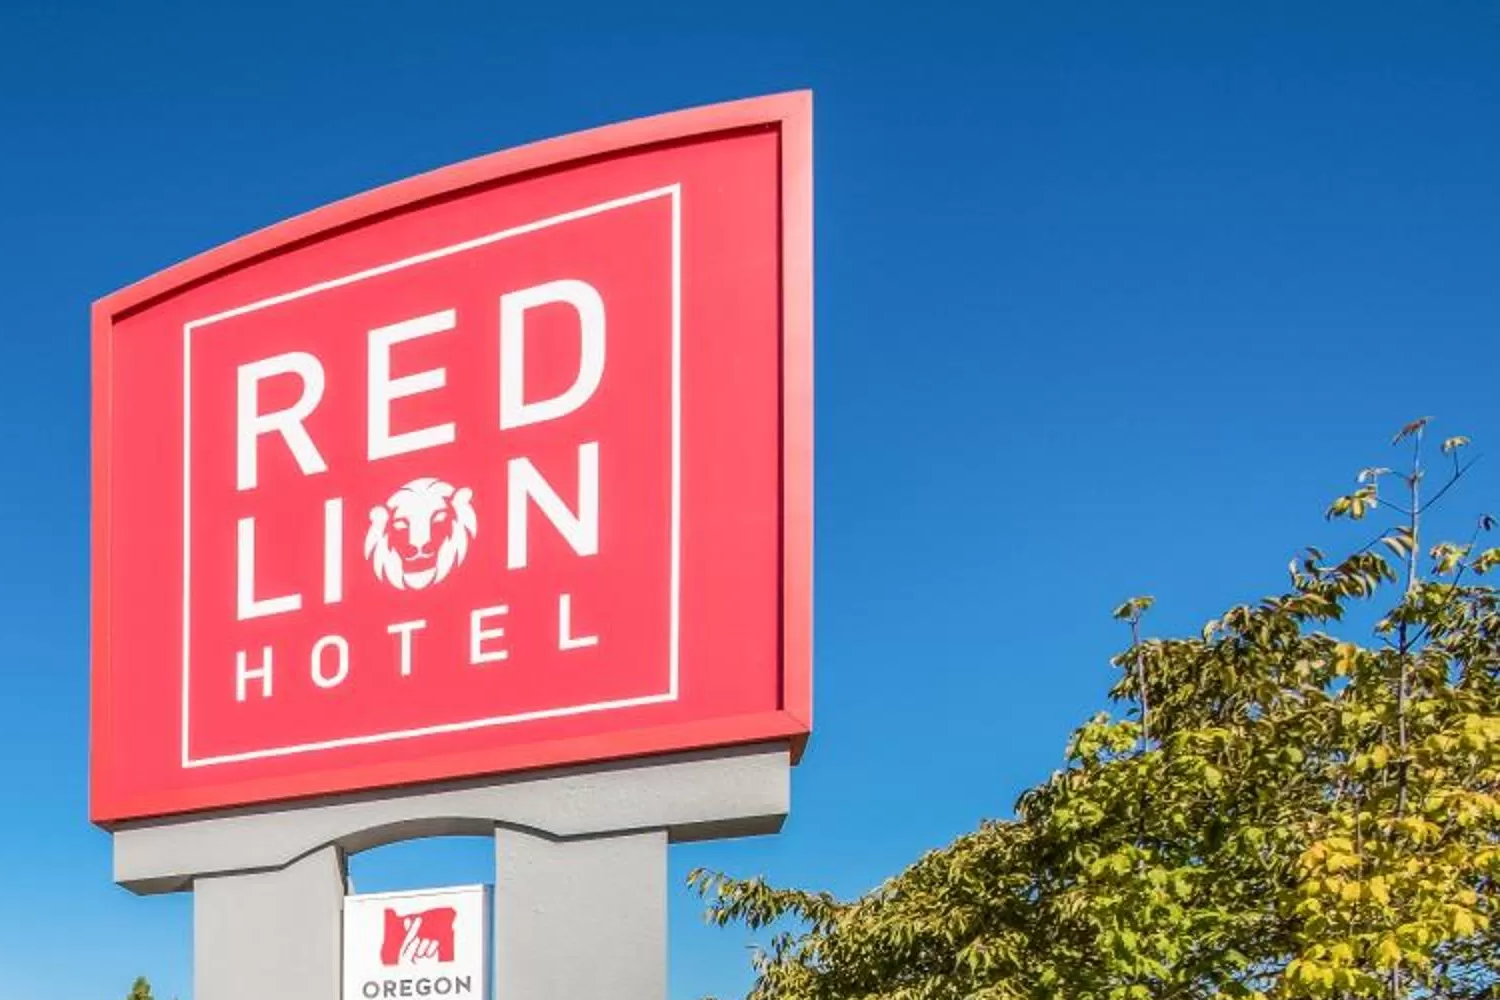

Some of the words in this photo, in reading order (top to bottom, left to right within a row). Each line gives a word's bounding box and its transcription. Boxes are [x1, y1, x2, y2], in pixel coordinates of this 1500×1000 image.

[237, 279, 606, 491] RED
[236, 593, 599, 702] HOTEL
[362, 975, 472, 999] OREGON
